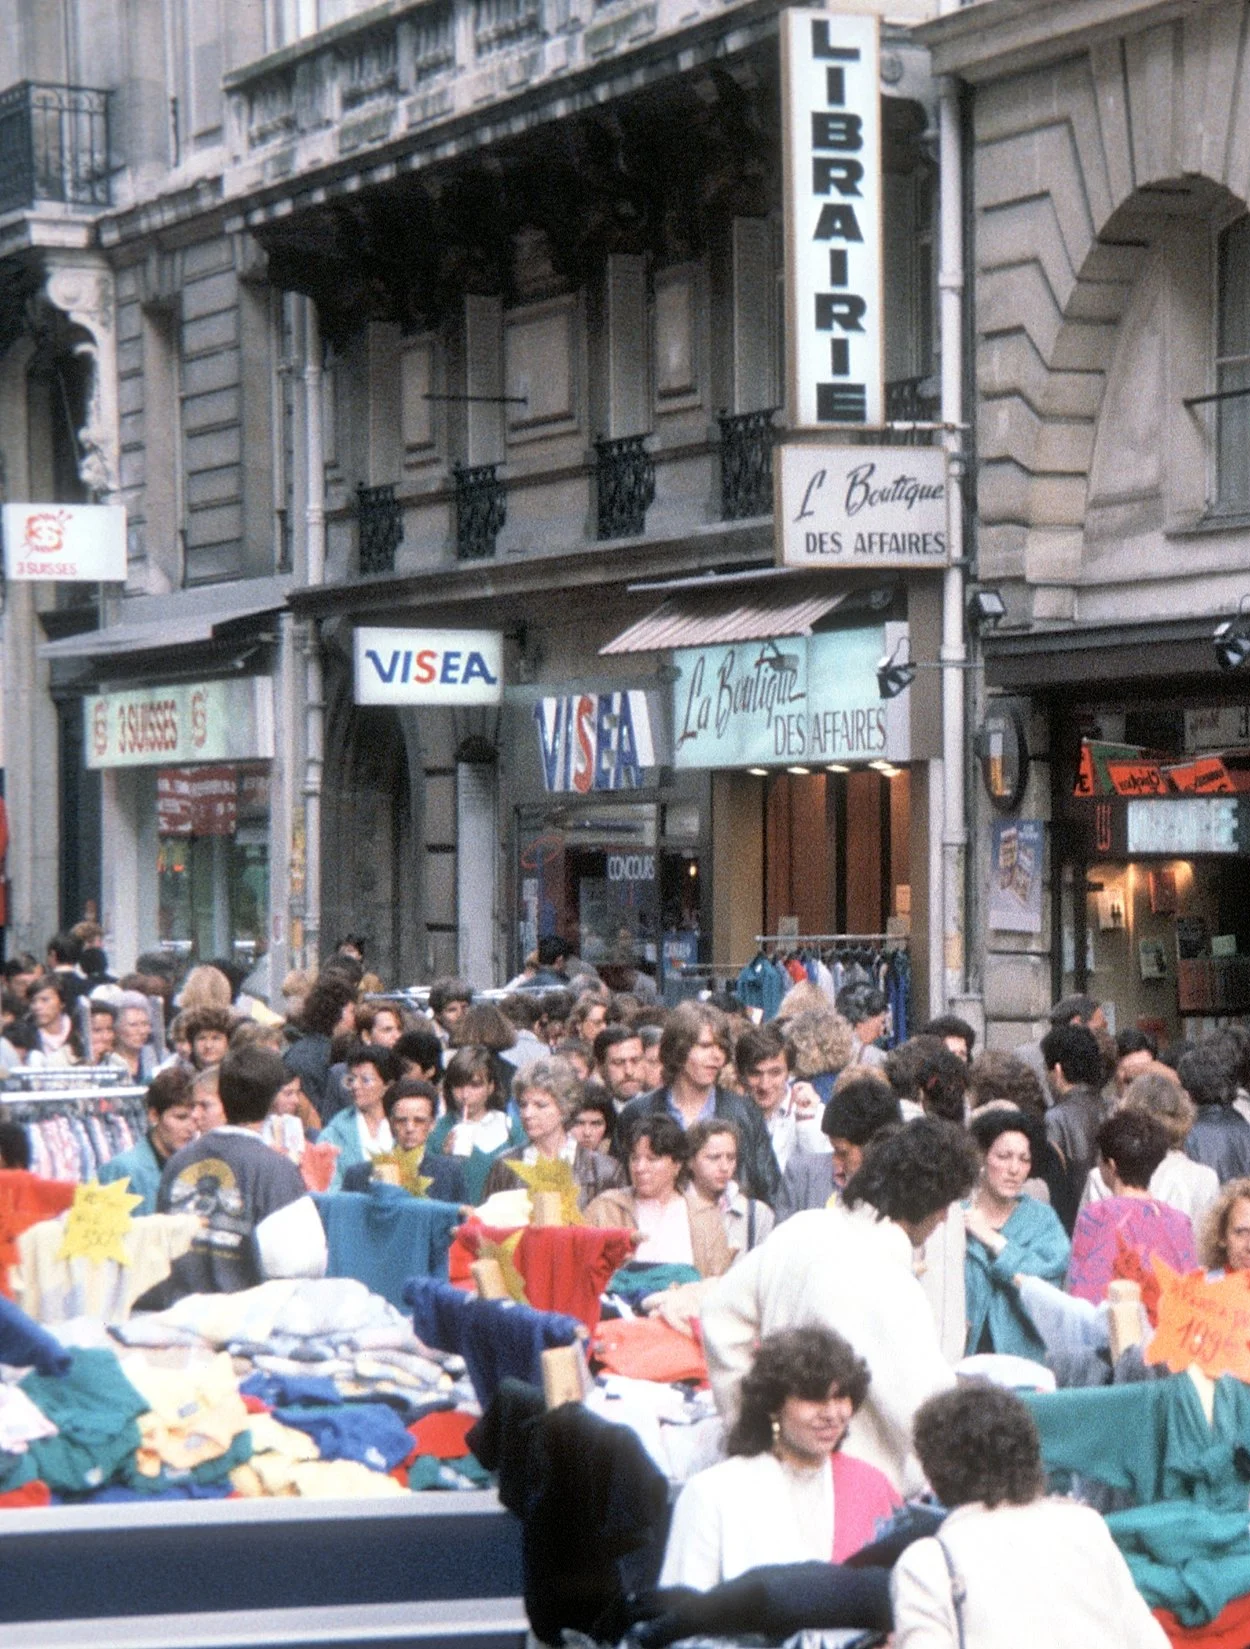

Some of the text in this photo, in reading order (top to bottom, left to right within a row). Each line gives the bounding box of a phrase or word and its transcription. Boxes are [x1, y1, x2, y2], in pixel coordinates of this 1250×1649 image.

[810, 19, 867, 422] LIBRAIRIE
[844, 462, 946, 518] Boutique
[27, 562, 77, 576] SUISSES
[805, 531, 946, 554] DES AFFAIRES
[364, 649, 498, 686] VISEA
[127, 698, 178, 753] SUISSES
[675, 650, 807, 748] La Boutique
[533, 689, 647, 795] VISEA
[773, 707, 887, 757] DES AFFAIRES
